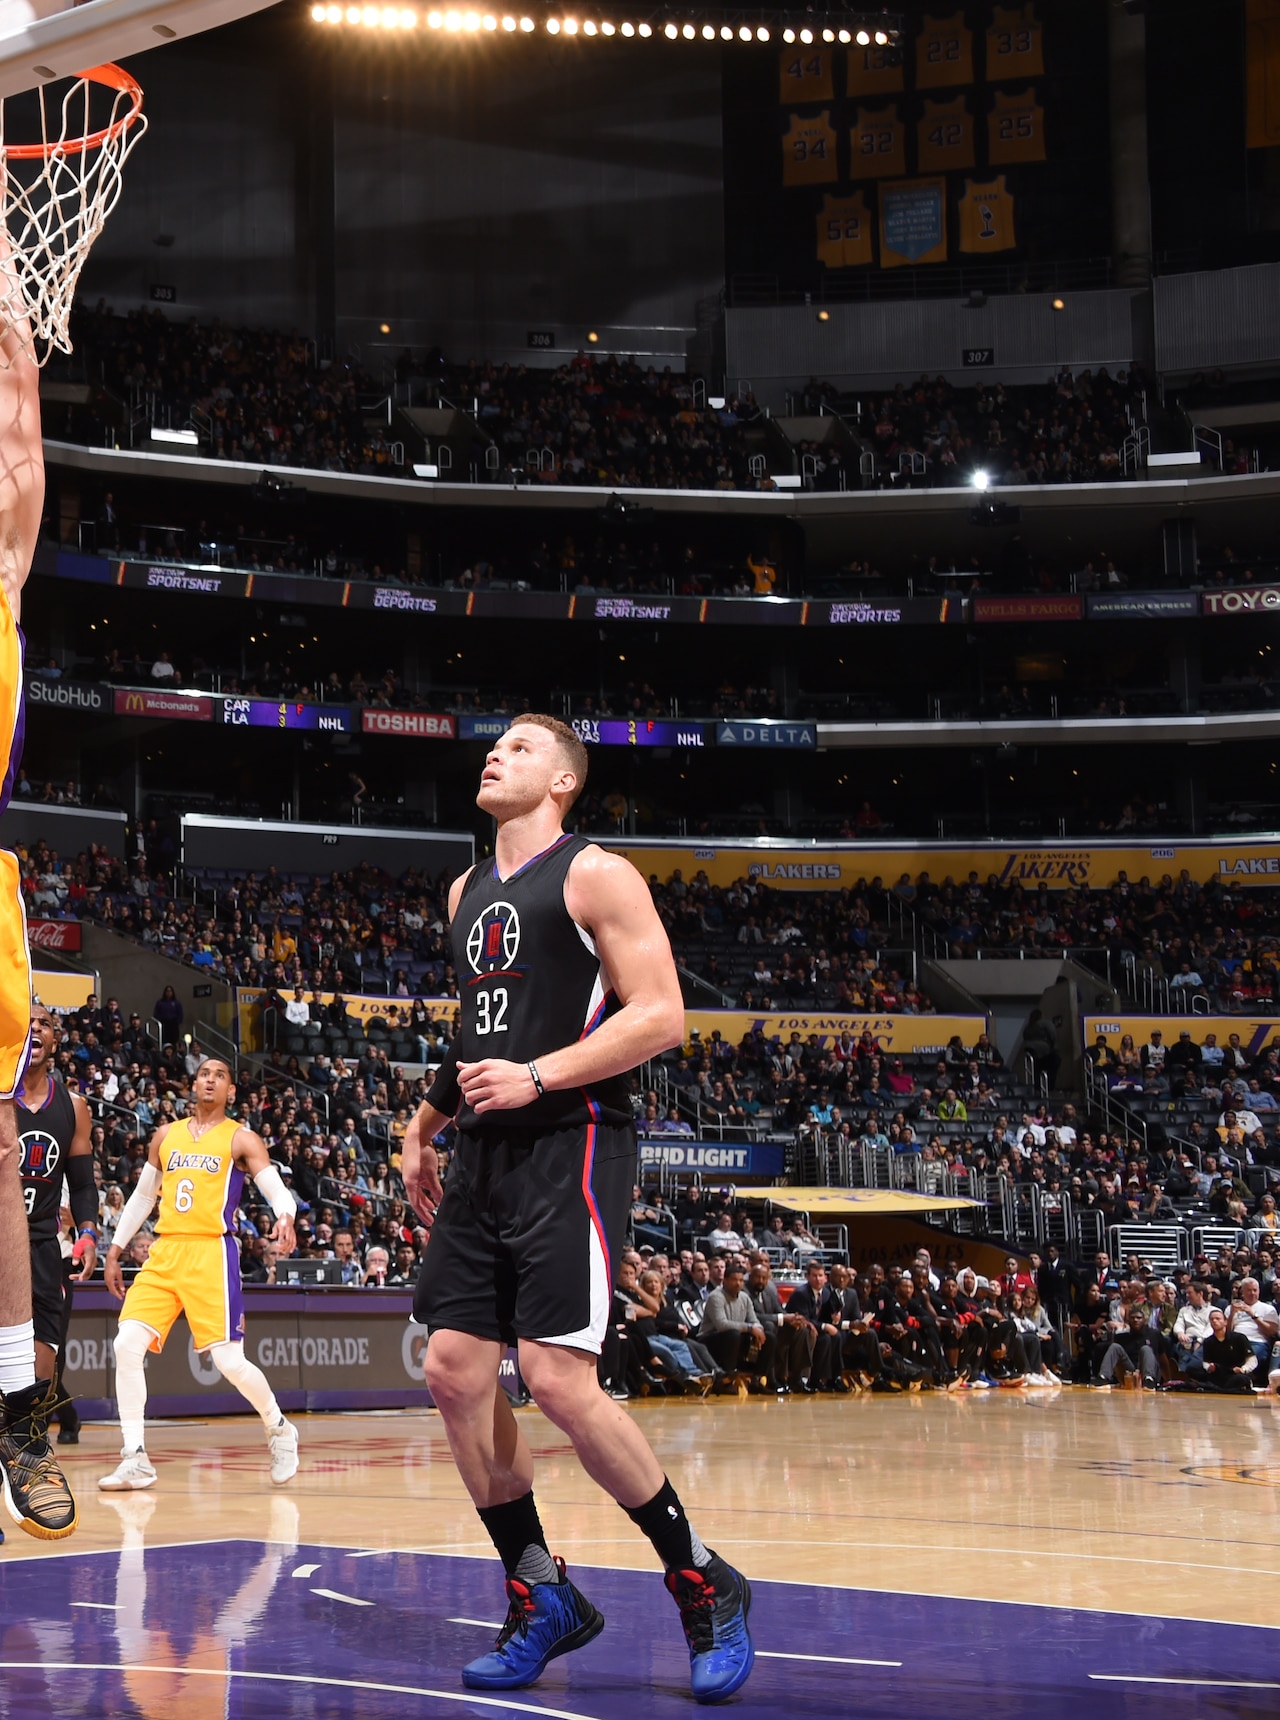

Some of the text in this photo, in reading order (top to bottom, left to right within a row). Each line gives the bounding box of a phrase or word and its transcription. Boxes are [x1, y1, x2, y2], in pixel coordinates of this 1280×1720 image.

[927, 39, 960, 63] 22
[997, 31, 1032, 54] 33
[787, 56, 821, 78] 44
[928, 124, 963, 147] 42
[999, 115, 1033, 139] 25
[793, 139, 826, 161] 34
[861, 132, 894, 155] 32
[827, 218, 861, 241] 52
[154, 288, 172, 300] 305
[532, 334, 550, 346] 306
[968, 352, 989, 364] 307
[147, 574, 222, 592] SPORTSNET
[373, 594, 438, 612] DEPORTES
[594, 605, 671, 619] SPORTSNET
[977, 603, 1080, 616] WELLS FARGO
[1092, 601, 1192, 612] AMERICAN EXPRESS
[830, 608, 902, 624] DEPORTES
[29, 681, 102, 708] StubHub
[147, 699, 200, 713] McDonald's
[223, 698, 304, 716] CAR 4 F
[223, 711, 345, 731] FLA 3 NHL
[364, 712, 453, 735] TOSHIBA
[474, 723, 498, 736] BUD
[571, 719, 655, 733] CGY 2 F
[628, 733, 637, 746] 4
[677, 733, 705, 747] NHL
[743, 728, 812, 744] DELTA
[1046, 852, 1092, 860] ANGELES
[748, 863, 841, 880] @LAKERS
[997, 853, 1092, 886] LAKERS
[360, 1004, 388, 1014] LOS
[475, 987, 509, 1036] 32
[778, 1019, 895, 1031] LOS ANGELES
[1095, 1023, 1120, 1034] 106
[166, 1150, 222, 1174] LAKERS
[640, 1145, 748, 1169] BUD LIGHT
[23, 1187, 37, 1216] 3
[175, 1178, 194, 1213] 6
[859, 1243, 893, 1264] LOS
[258, 1336, 370, 1368] GATORADE
